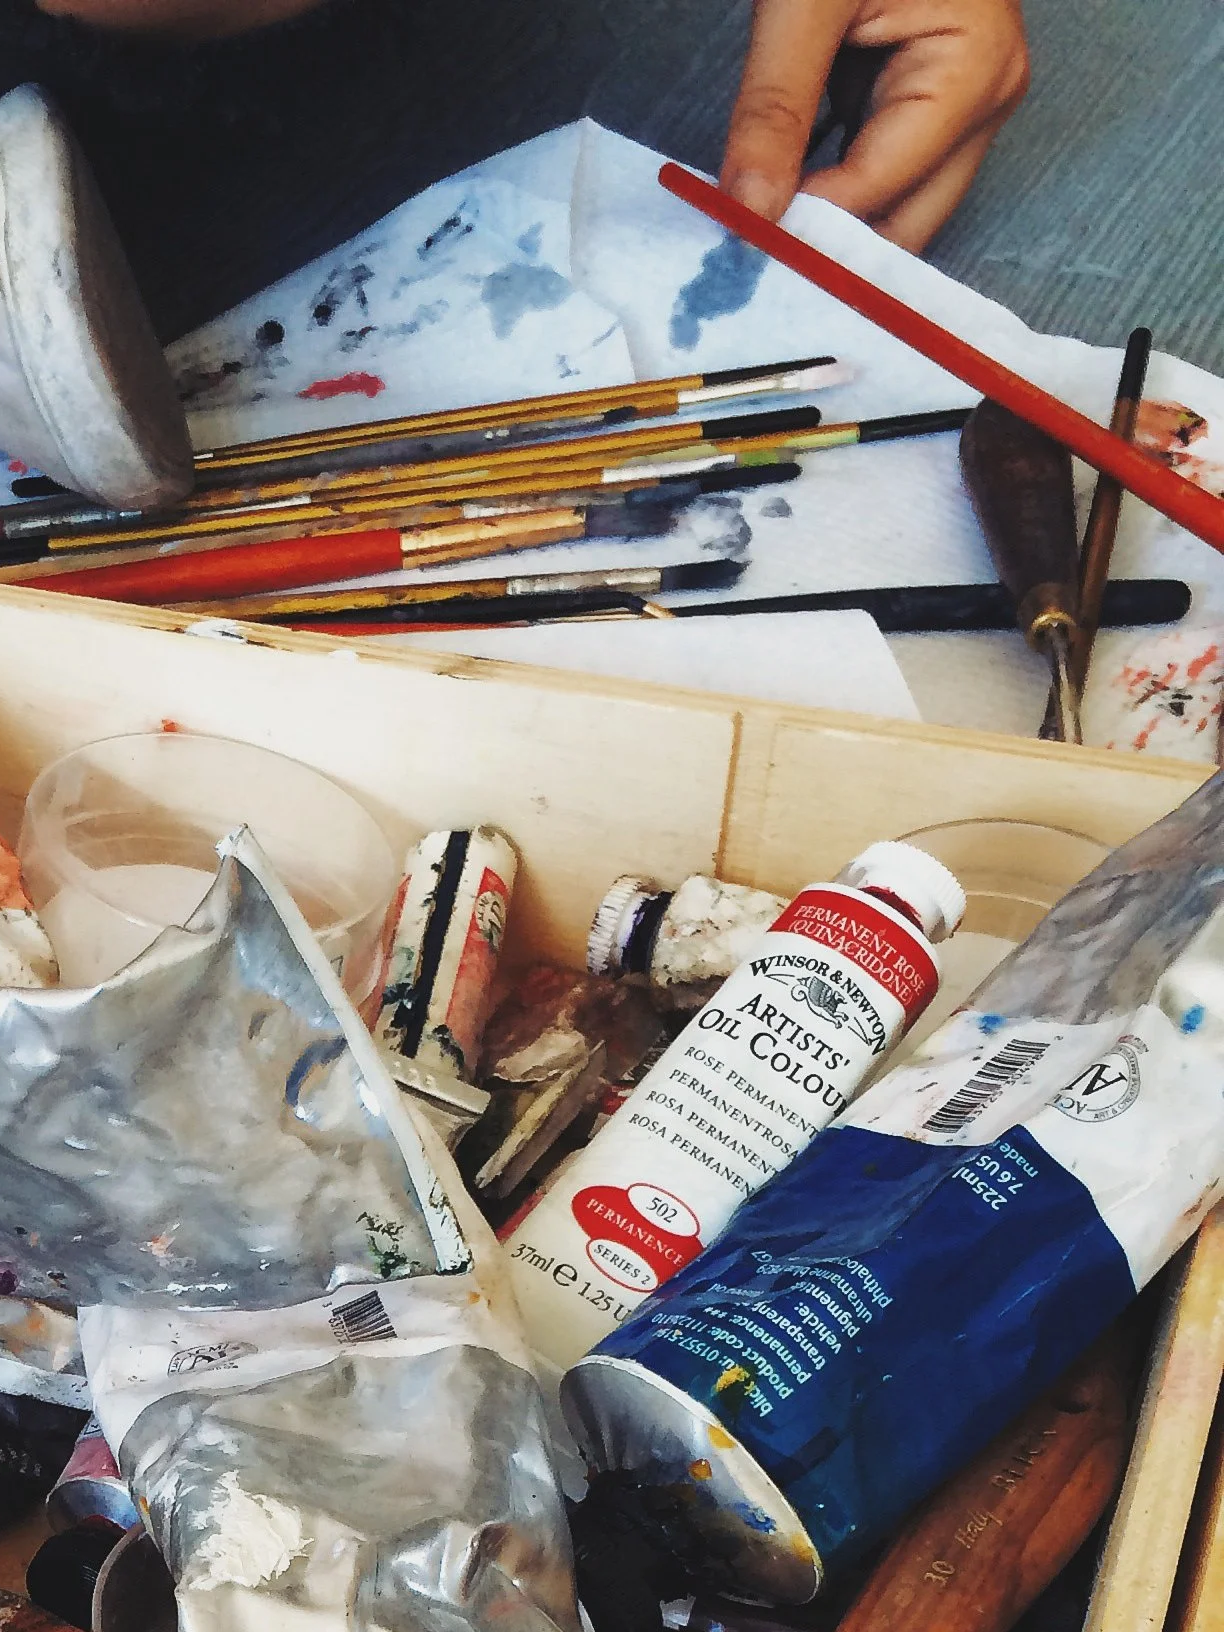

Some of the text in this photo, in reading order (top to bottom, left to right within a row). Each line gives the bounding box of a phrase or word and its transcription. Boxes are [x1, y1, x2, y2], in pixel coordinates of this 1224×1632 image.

[788, 919, 914, 1005] (QUINACRIDONE)
[794, 905, 926, 996] PERMANENT ROSE
[697, 1008, 742, 1041] OIL
[736, 993, 851, 1070] ARTISTS'
[749, 954, 888, 1056] WINSOR & NEWTON
[645, 1090, 683, 1116] ROSA
[669, 1069, 799, 1159] PERMANENTROSA
[684, 1046, 819, 1140] ROSE PERMANENT
[628, 1113, 667, 1139] ROSA
[976, 1155, 1024, 1195] 7.6 US
[999, 1141, 1039, 1179] made
[646, 1197, 678, 1223] 502
[952, 1166, 1008, 1211] 225ml
[586, 1198, 685, 1267] PERMANENCE
[510, 1243, 555, 1272] 37ml
[577, 1281, 615, 1312] 1.25
[613, 1303, 632, 1322] U
[593, 1244, 651, 1285] SERIES 2
[711, 1326, 745, 1349] code:
[731, 1313, 812, 1385] permanence:
[753, 1299, 826, 1372] transparent
[794, 1301, 842, 1355] vehicle:
[751, 1351, 794, 1400] product
